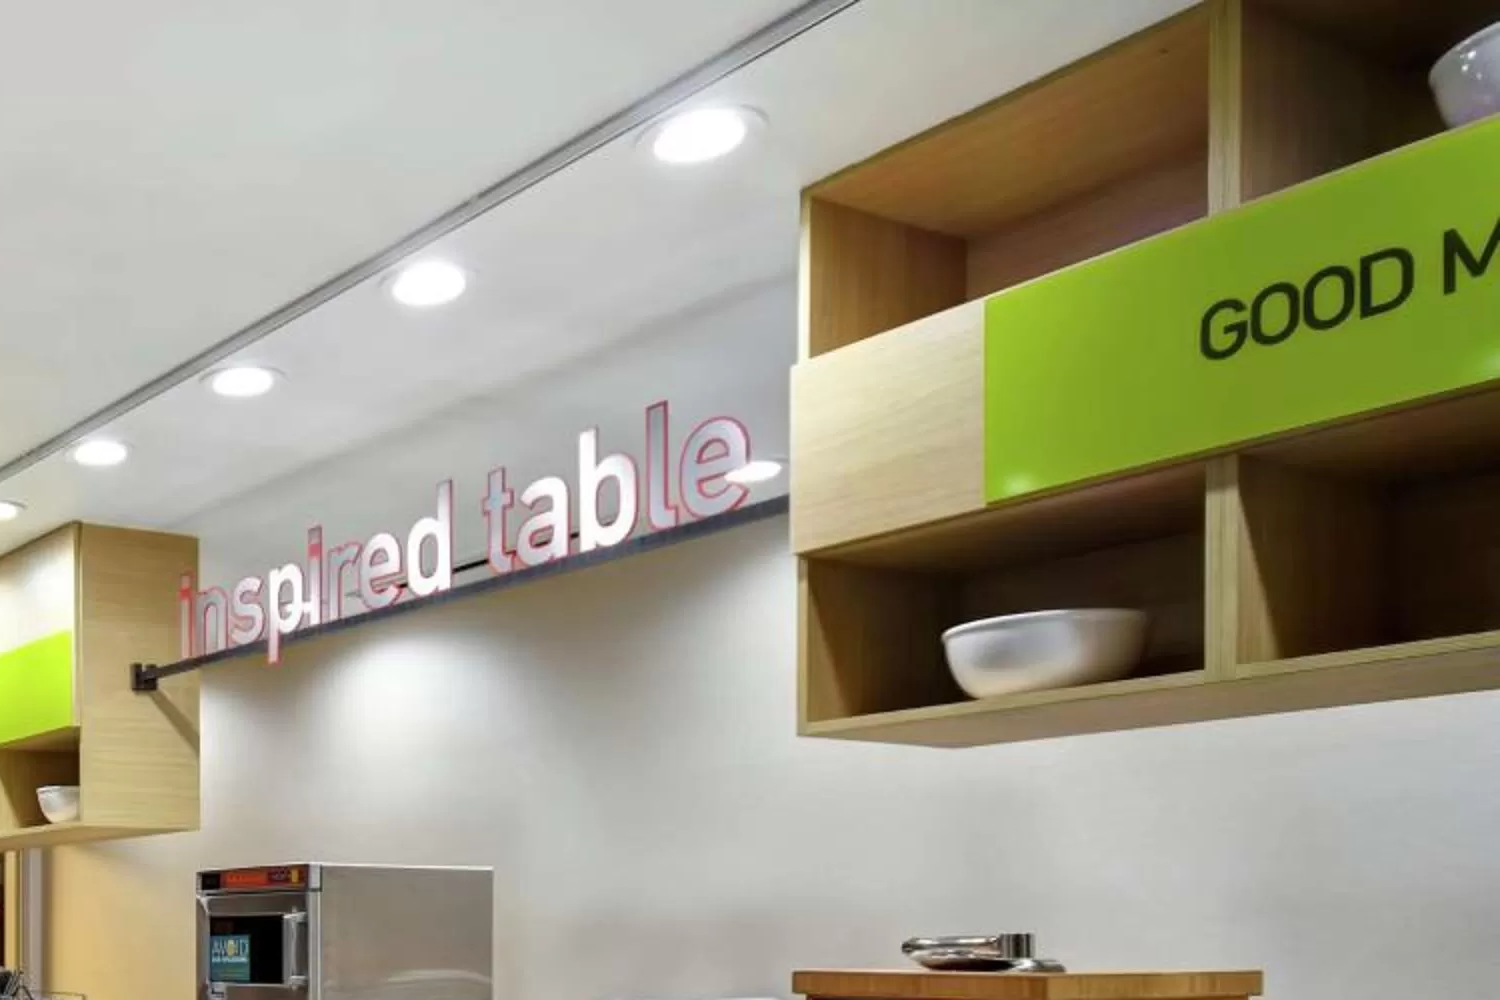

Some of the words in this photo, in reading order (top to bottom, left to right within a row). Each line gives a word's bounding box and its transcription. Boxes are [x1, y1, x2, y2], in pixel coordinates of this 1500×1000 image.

[1200, 247, 1414, 361] GOOD
[178, 478, 452, 665] inspired
[482, 400, 752, 575] table
